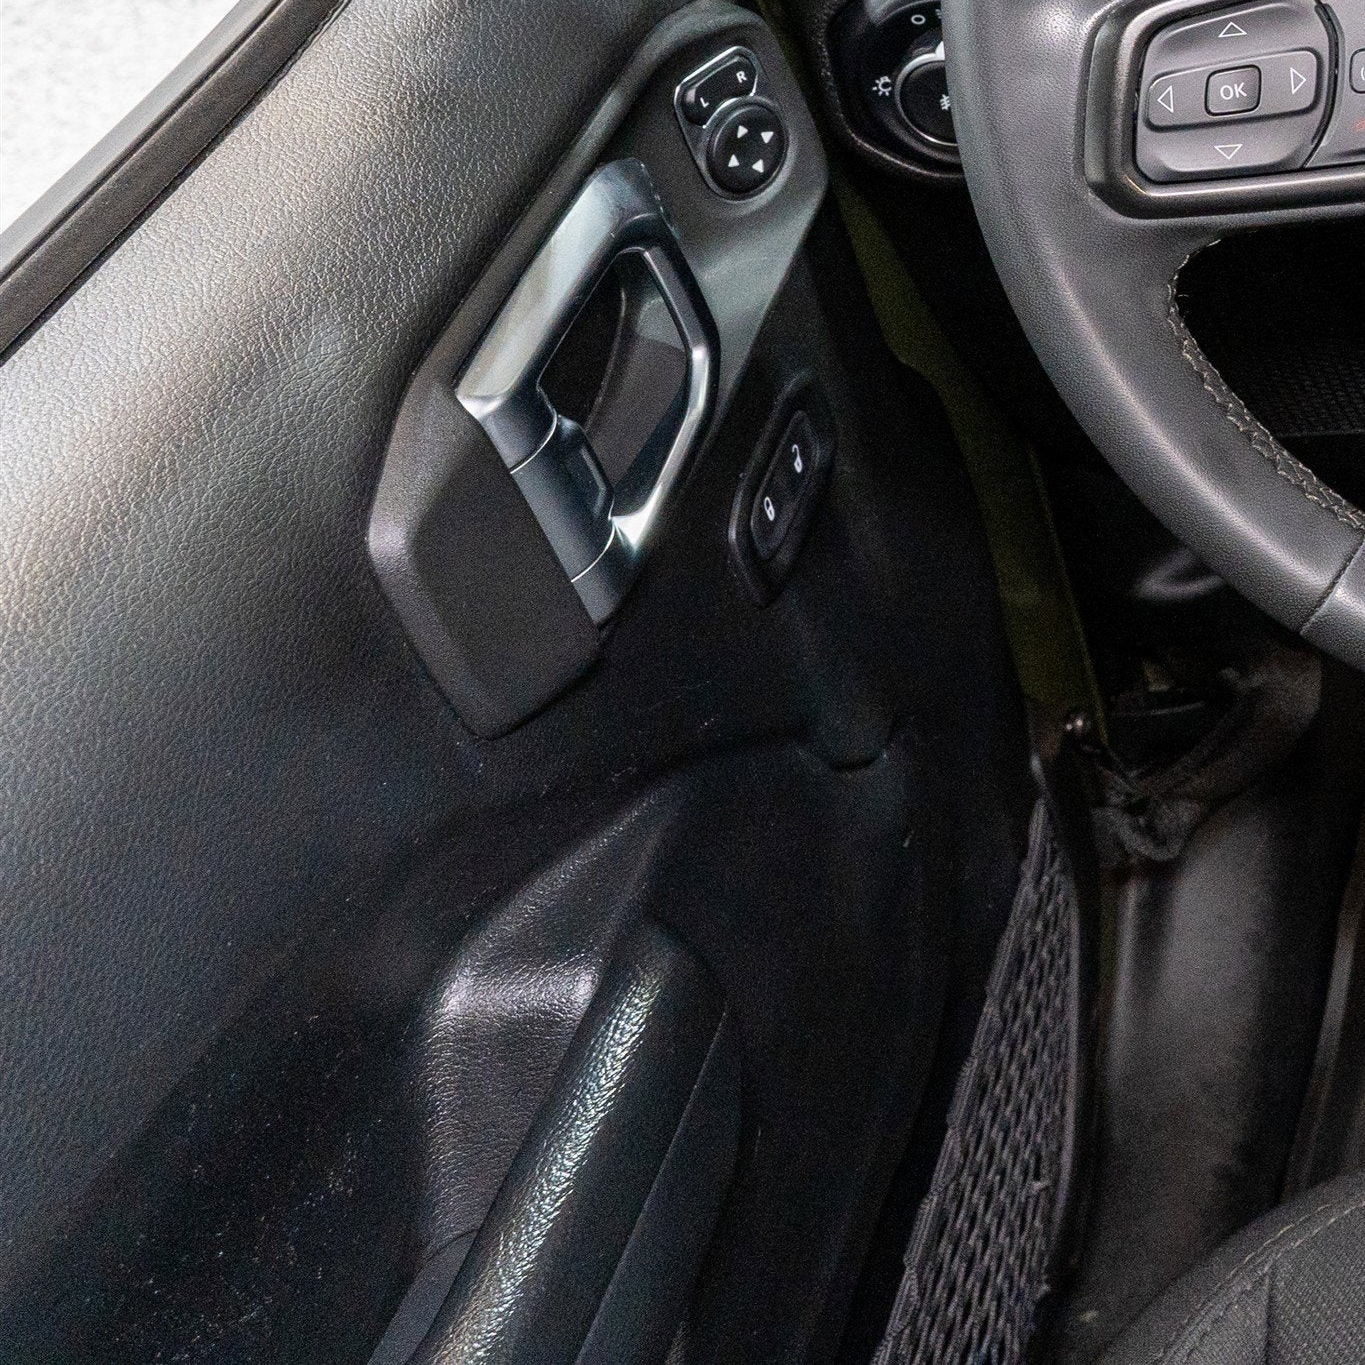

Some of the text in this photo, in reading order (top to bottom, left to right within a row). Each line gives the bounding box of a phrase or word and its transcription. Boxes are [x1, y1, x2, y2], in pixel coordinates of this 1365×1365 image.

[736, 71, 747, 83] R
[1220, 82, 1247, 101] OK
[700, 97, 709, 108] L
